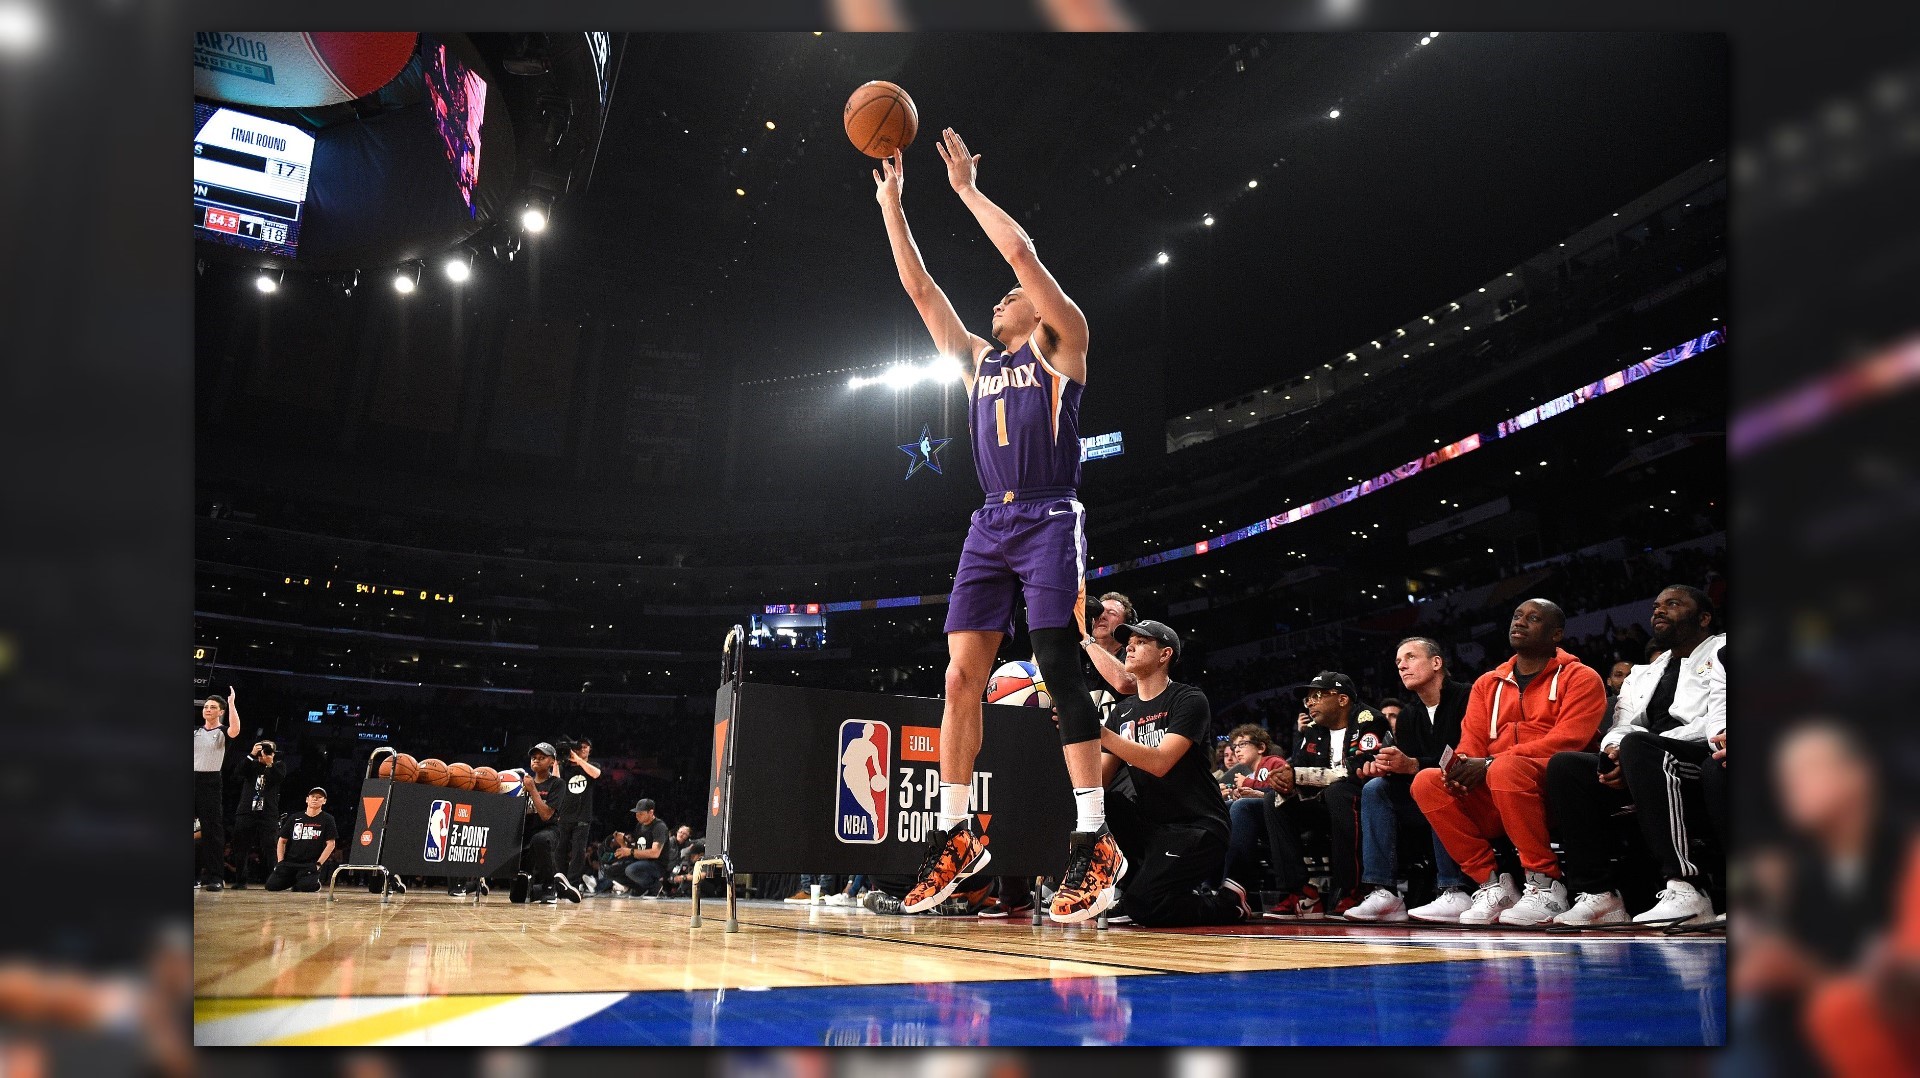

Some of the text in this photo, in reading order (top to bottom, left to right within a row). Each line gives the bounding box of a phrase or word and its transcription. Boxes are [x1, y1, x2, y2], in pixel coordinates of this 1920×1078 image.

[231, 127, 287, 152] FINAL ROUND
[277, 163, 296, 177] 17
[208, 212, 237, 229] 54.3
[245, 222, 255, 236] 1
[995, 398, 1010, 447] 1
[356, 583, 376, 594] 54.1
[910, 735, 934, 752] JBL
[570, 780, 587, 790] TNT
[843, 814, 868, 835] NBA
